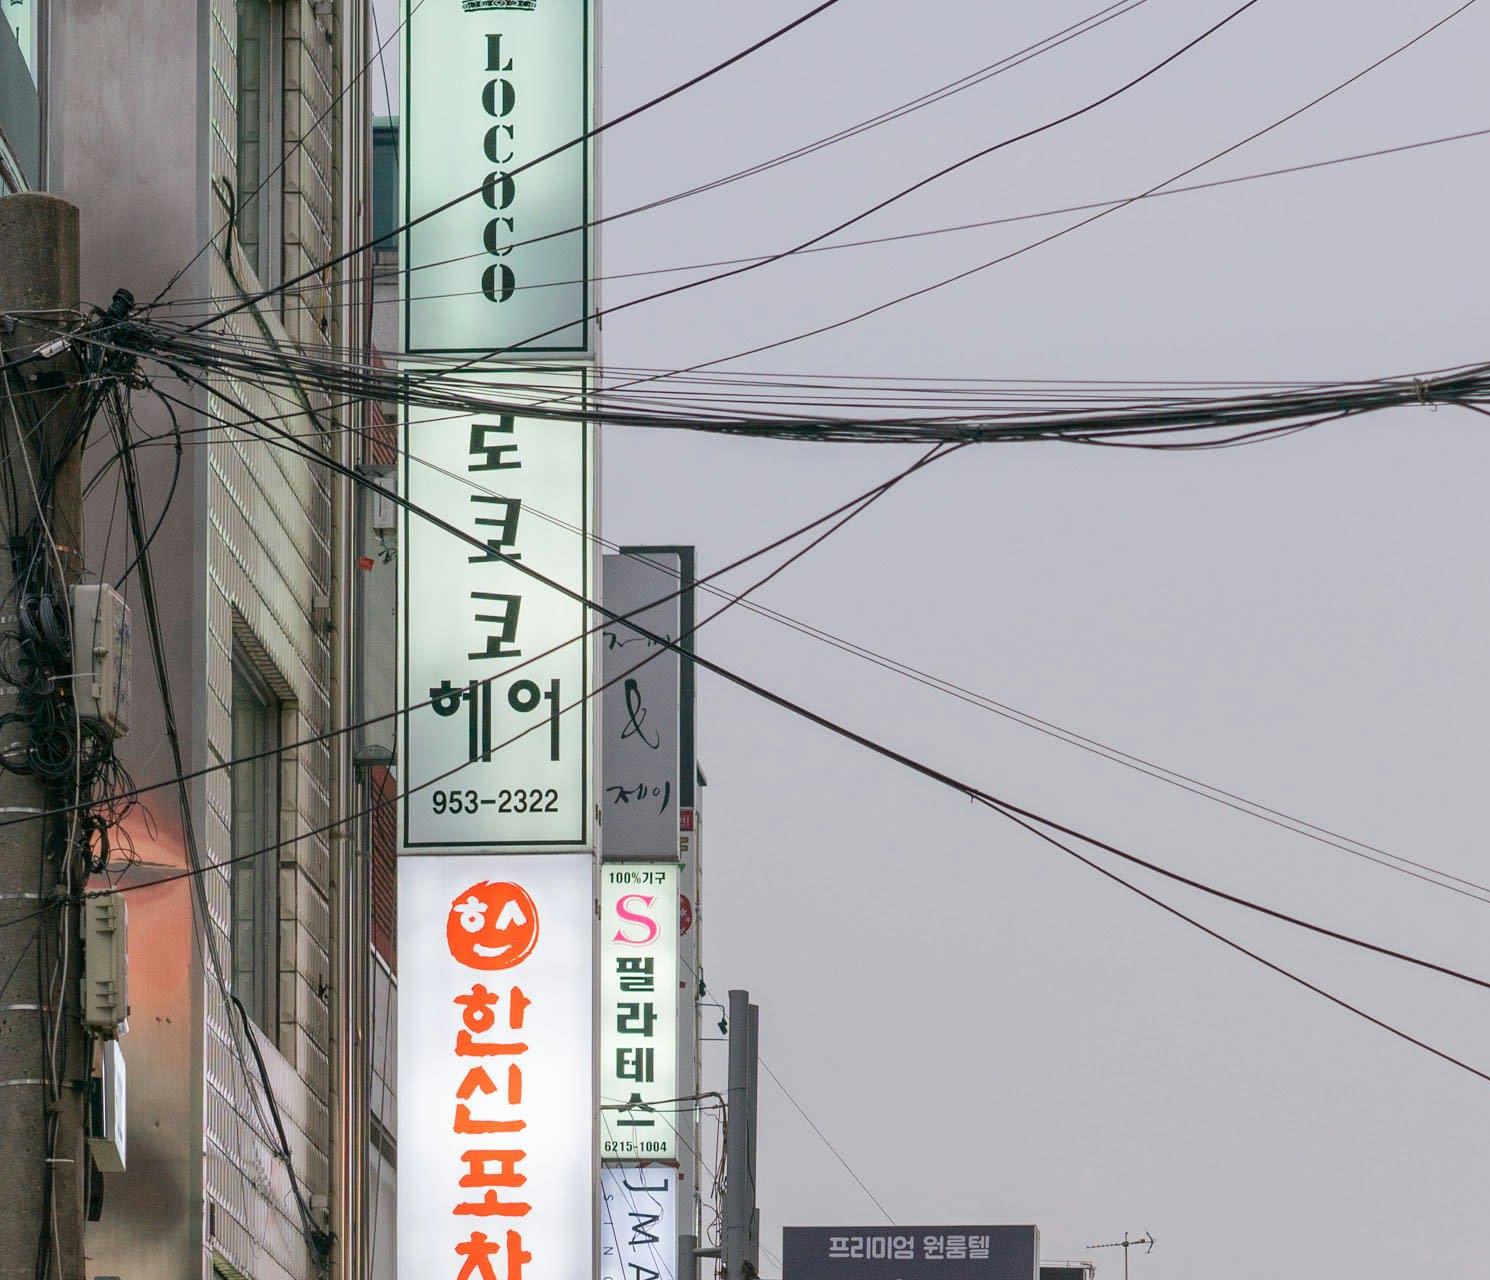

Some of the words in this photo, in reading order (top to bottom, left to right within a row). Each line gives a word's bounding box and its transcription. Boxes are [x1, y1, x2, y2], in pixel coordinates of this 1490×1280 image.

[481, 33, 517, 303] LOCOCO
[467, 410, 522, 660] 로코코
[429, 678, 561, 763] 헤어
[432, 789, 559, 815] 953-2322
[608, 871, 667, 886] 100%기구
[611, 894, 662, 948] S
[615, 955, 658, 1129] 필라테스
[604, 1140, 668, 1154] 6215-1004
[828, 1235, 915, 1260] 프리미엄
[922, 1235, 990, 1260] 원룸텔
